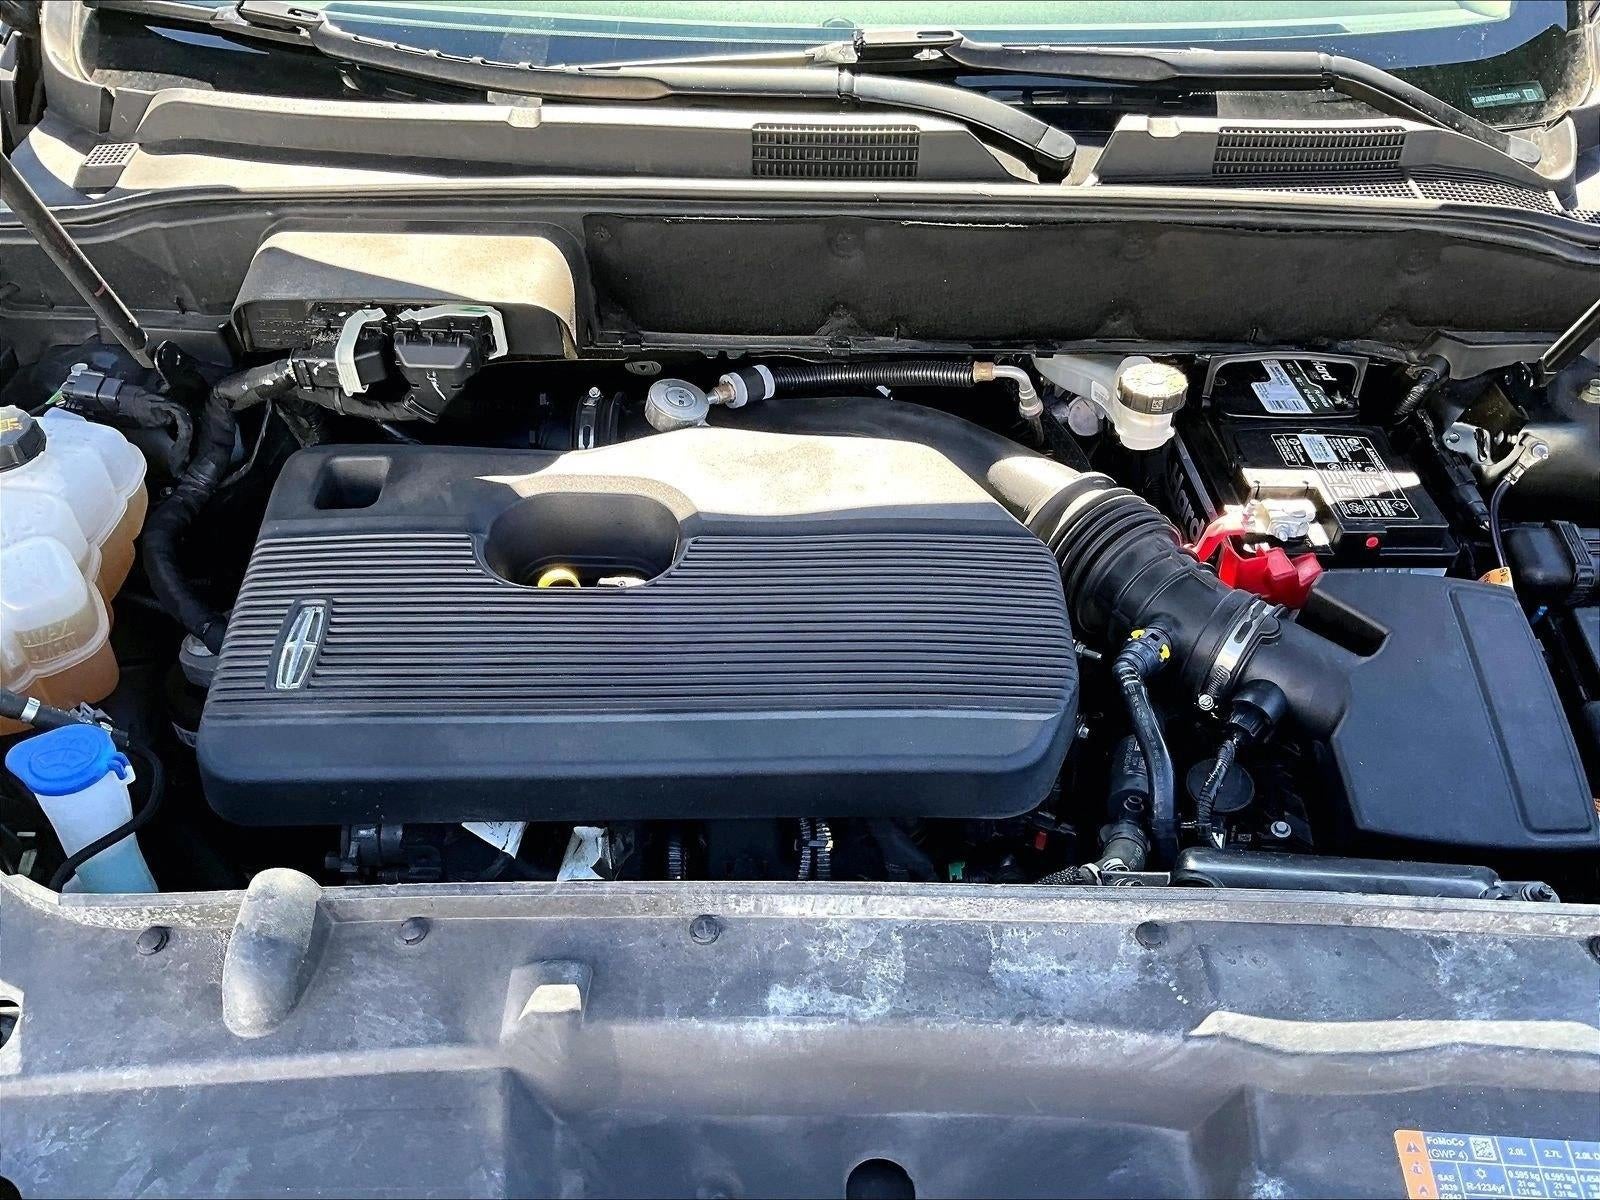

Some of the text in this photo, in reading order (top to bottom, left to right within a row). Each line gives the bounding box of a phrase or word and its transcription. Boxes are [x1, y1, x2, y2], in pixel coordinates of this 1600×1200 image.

[1426, 1136, 1465, 1147] FoMoCo
[1428, 1149, 1469, 1162] (GWP 4)
[1508, 1147, 1527, 1156] 2.0L
[1543, 1149, 1563, 1158] 2.7L
[1437, 1174, 1455, 1182] SAE
[1508, 1170, 1541, 1182] 0.595 kg
[1544, 1172, 1577, 1184] 0.595 kg
[1466, 1182, 1505, 1194] R-1234yf
